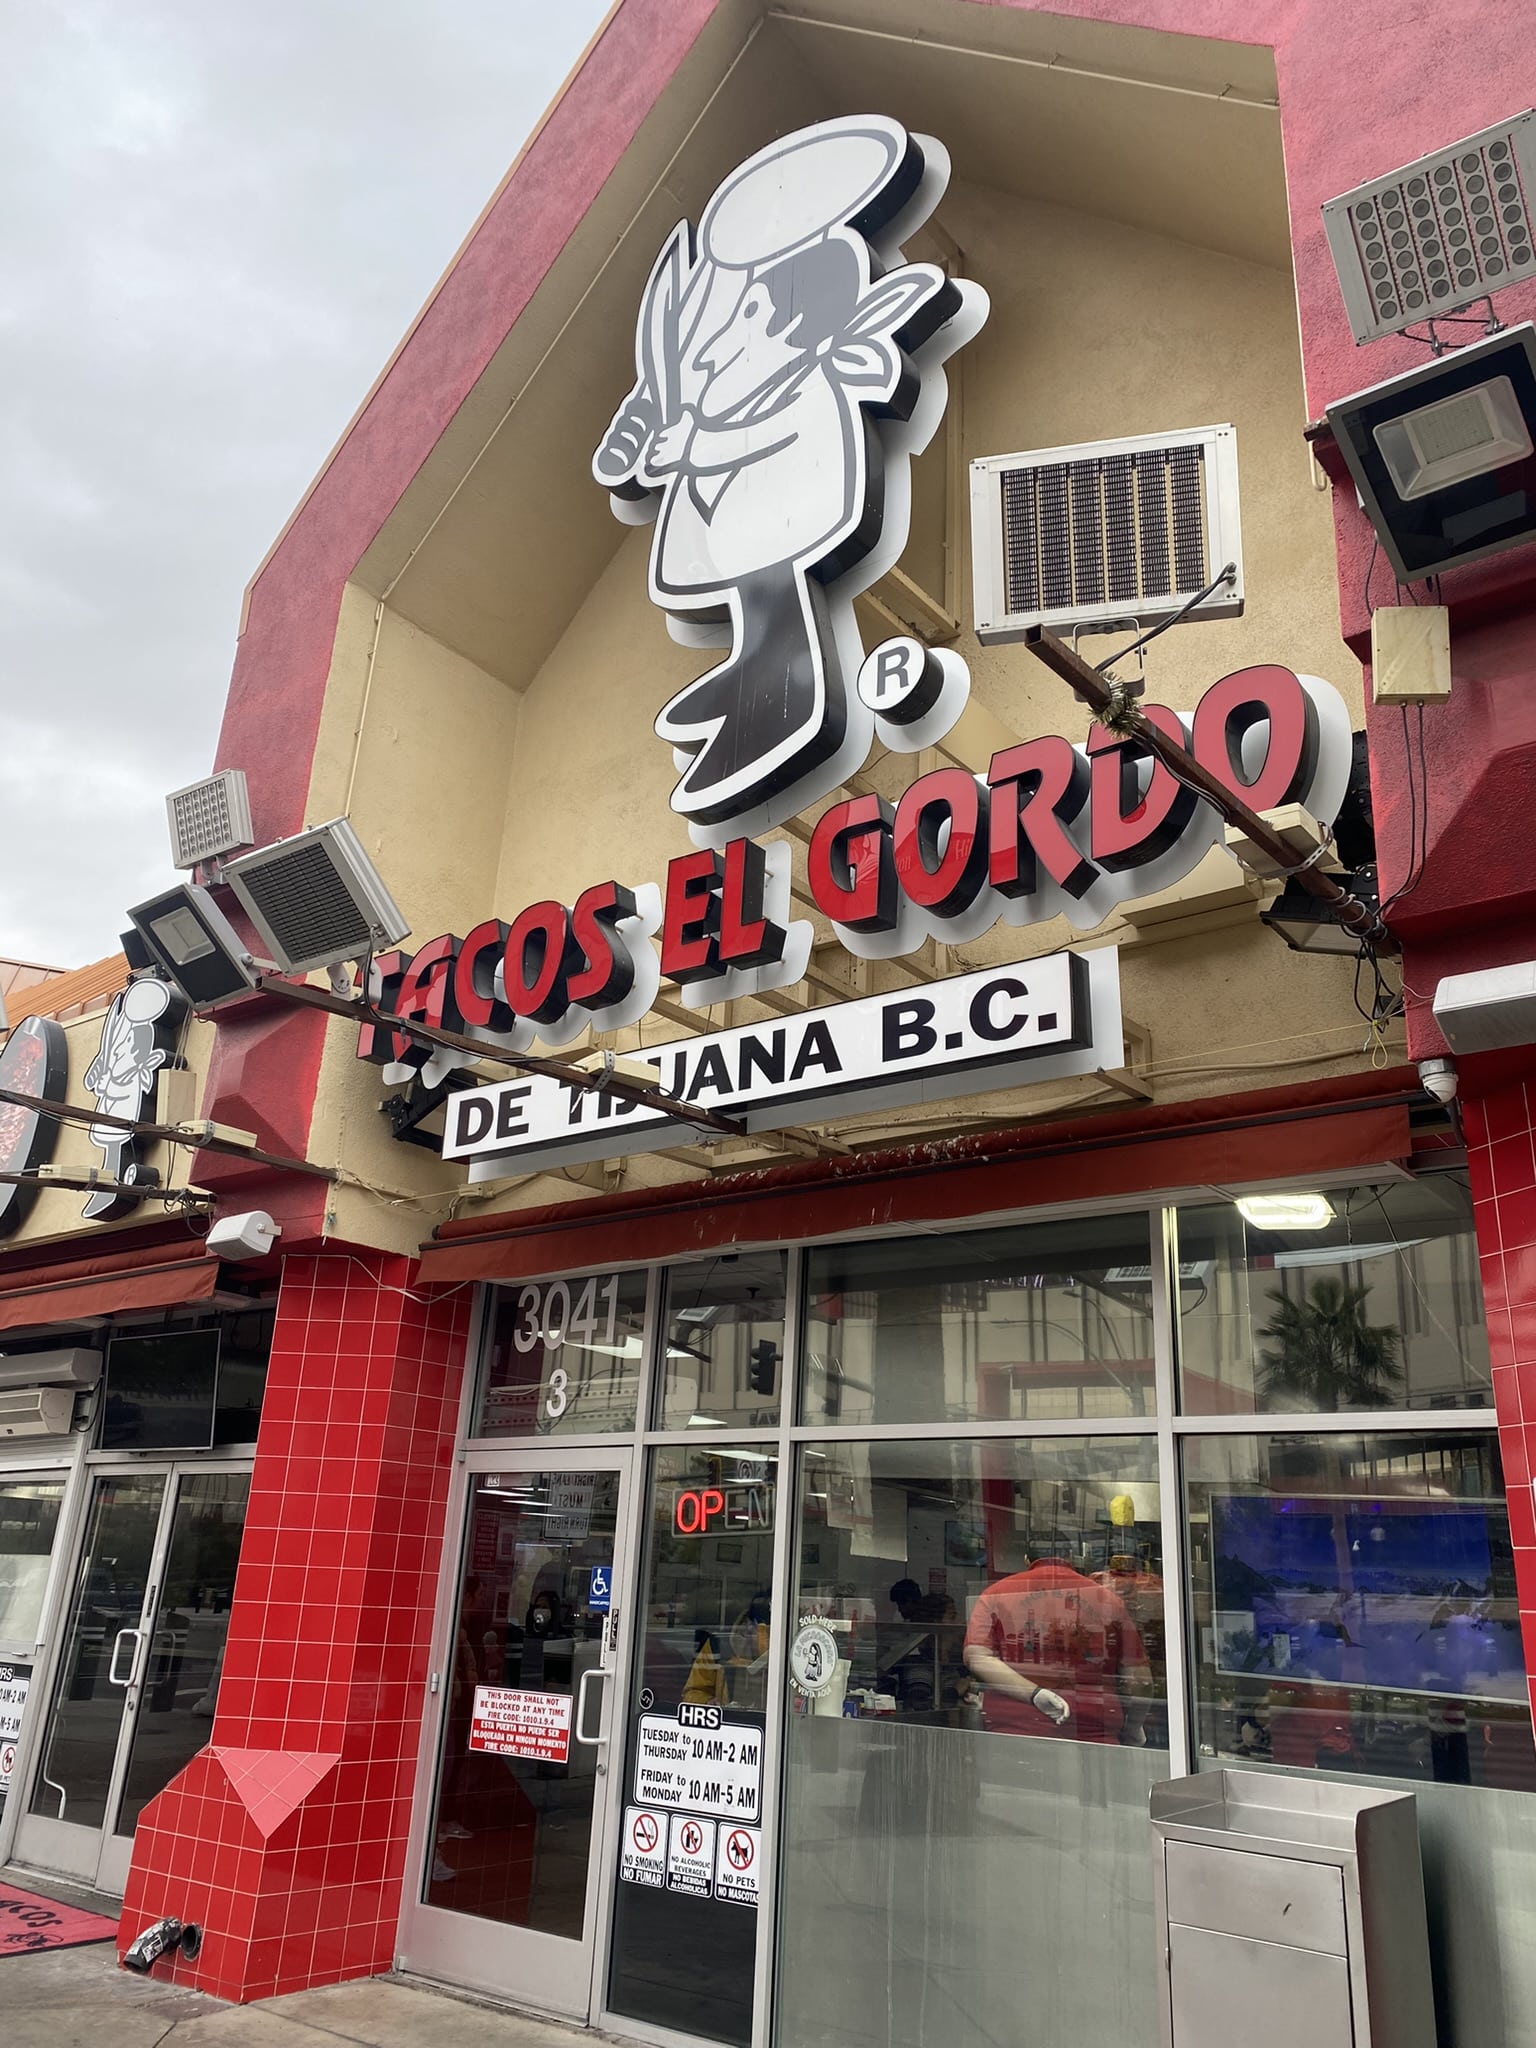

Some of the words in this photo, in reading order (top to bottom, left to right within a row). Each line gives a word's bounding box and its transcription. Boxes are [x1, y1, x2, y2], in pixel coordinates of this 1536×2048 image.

[661, 837, 772, 977] EL
[807, 663, 1306, 926] GORDO
[456, 1086, 532, 1146] DE
[882, 977, 1058, 1062] B.C.
[513, 1274, 619, 1353] 3041
[546, 1368, 568, 1417] 3
[676, 1488, 776, 1533] OPEN
[799, 1614, 817, 1627] SOLD
[819, 1615, 837, 1633] HERE
[0, 1667, 12, 1681] RS
[487, 1691, 501, 1699] THIS
[504, 1693, 522, 1701] DOOR
[524, 1695, 544, 1704] SHALL
[546, 1698, 559, 1706] NOT
[798, 1686, 816, 1698] VENTA
[480, 1700, 488, 1708] BE
[490, 1701, 520, 1712] BLOCKED
[522, 1705, 530, 1713] AT
[533, 1706, 546, 1714] ANY
[548, 1708, 565, 1717] TIME
[487, 1711, 501, 1720] FIRE
[503, 1713, 521, 1721] CODE:
[681, 1706, 719, 1728] HRS
[480, 1721, 494, 1730] ESTA
[495, 1722, 517, 1732] PUERTA
[518, 1725, 527, 1733] NO
[527, 1725, 546, 1736] PUEDE
[547, 1729, 560, 1737] SER
[506, 1733, 514, 1742] EN
[642, 1728, 679, 1743] TUESDAY
[683, 1734, 691, 1745] to
[484, 1741, 498, 1750] FIRE
[644, 1745, 688, 1761] THURSDAY
[692, 1739, 704, 1759] 10
[739, 1744, 758, 1766] AM
[641, 1769, 673, 1784] FRIDAY
[677, 1775, 686, 1786] to
[642, 1786, 682, 1802] MONDAY
[689, 1780, 701, 1799] 10
[737, 1787, 756, 1809] AM
[624, 1854, 633, 1866] NO
[635, 1856, 664, 1871] SMOKING
[674, 1865, 707, 1877] BEVERAGES
[681, 1857, 711, 1869] ALCOHOLIC
[623, 1868, 634, 1880] NO
[636, 1870, 662, 1885] FUMAR
[723, 1873, 733, 1884] NO
[736, 1876, 756, 1888] PETS
[718, 1886, 727, 1897] NO
[0, 1900, 63, 1928] ACOS
